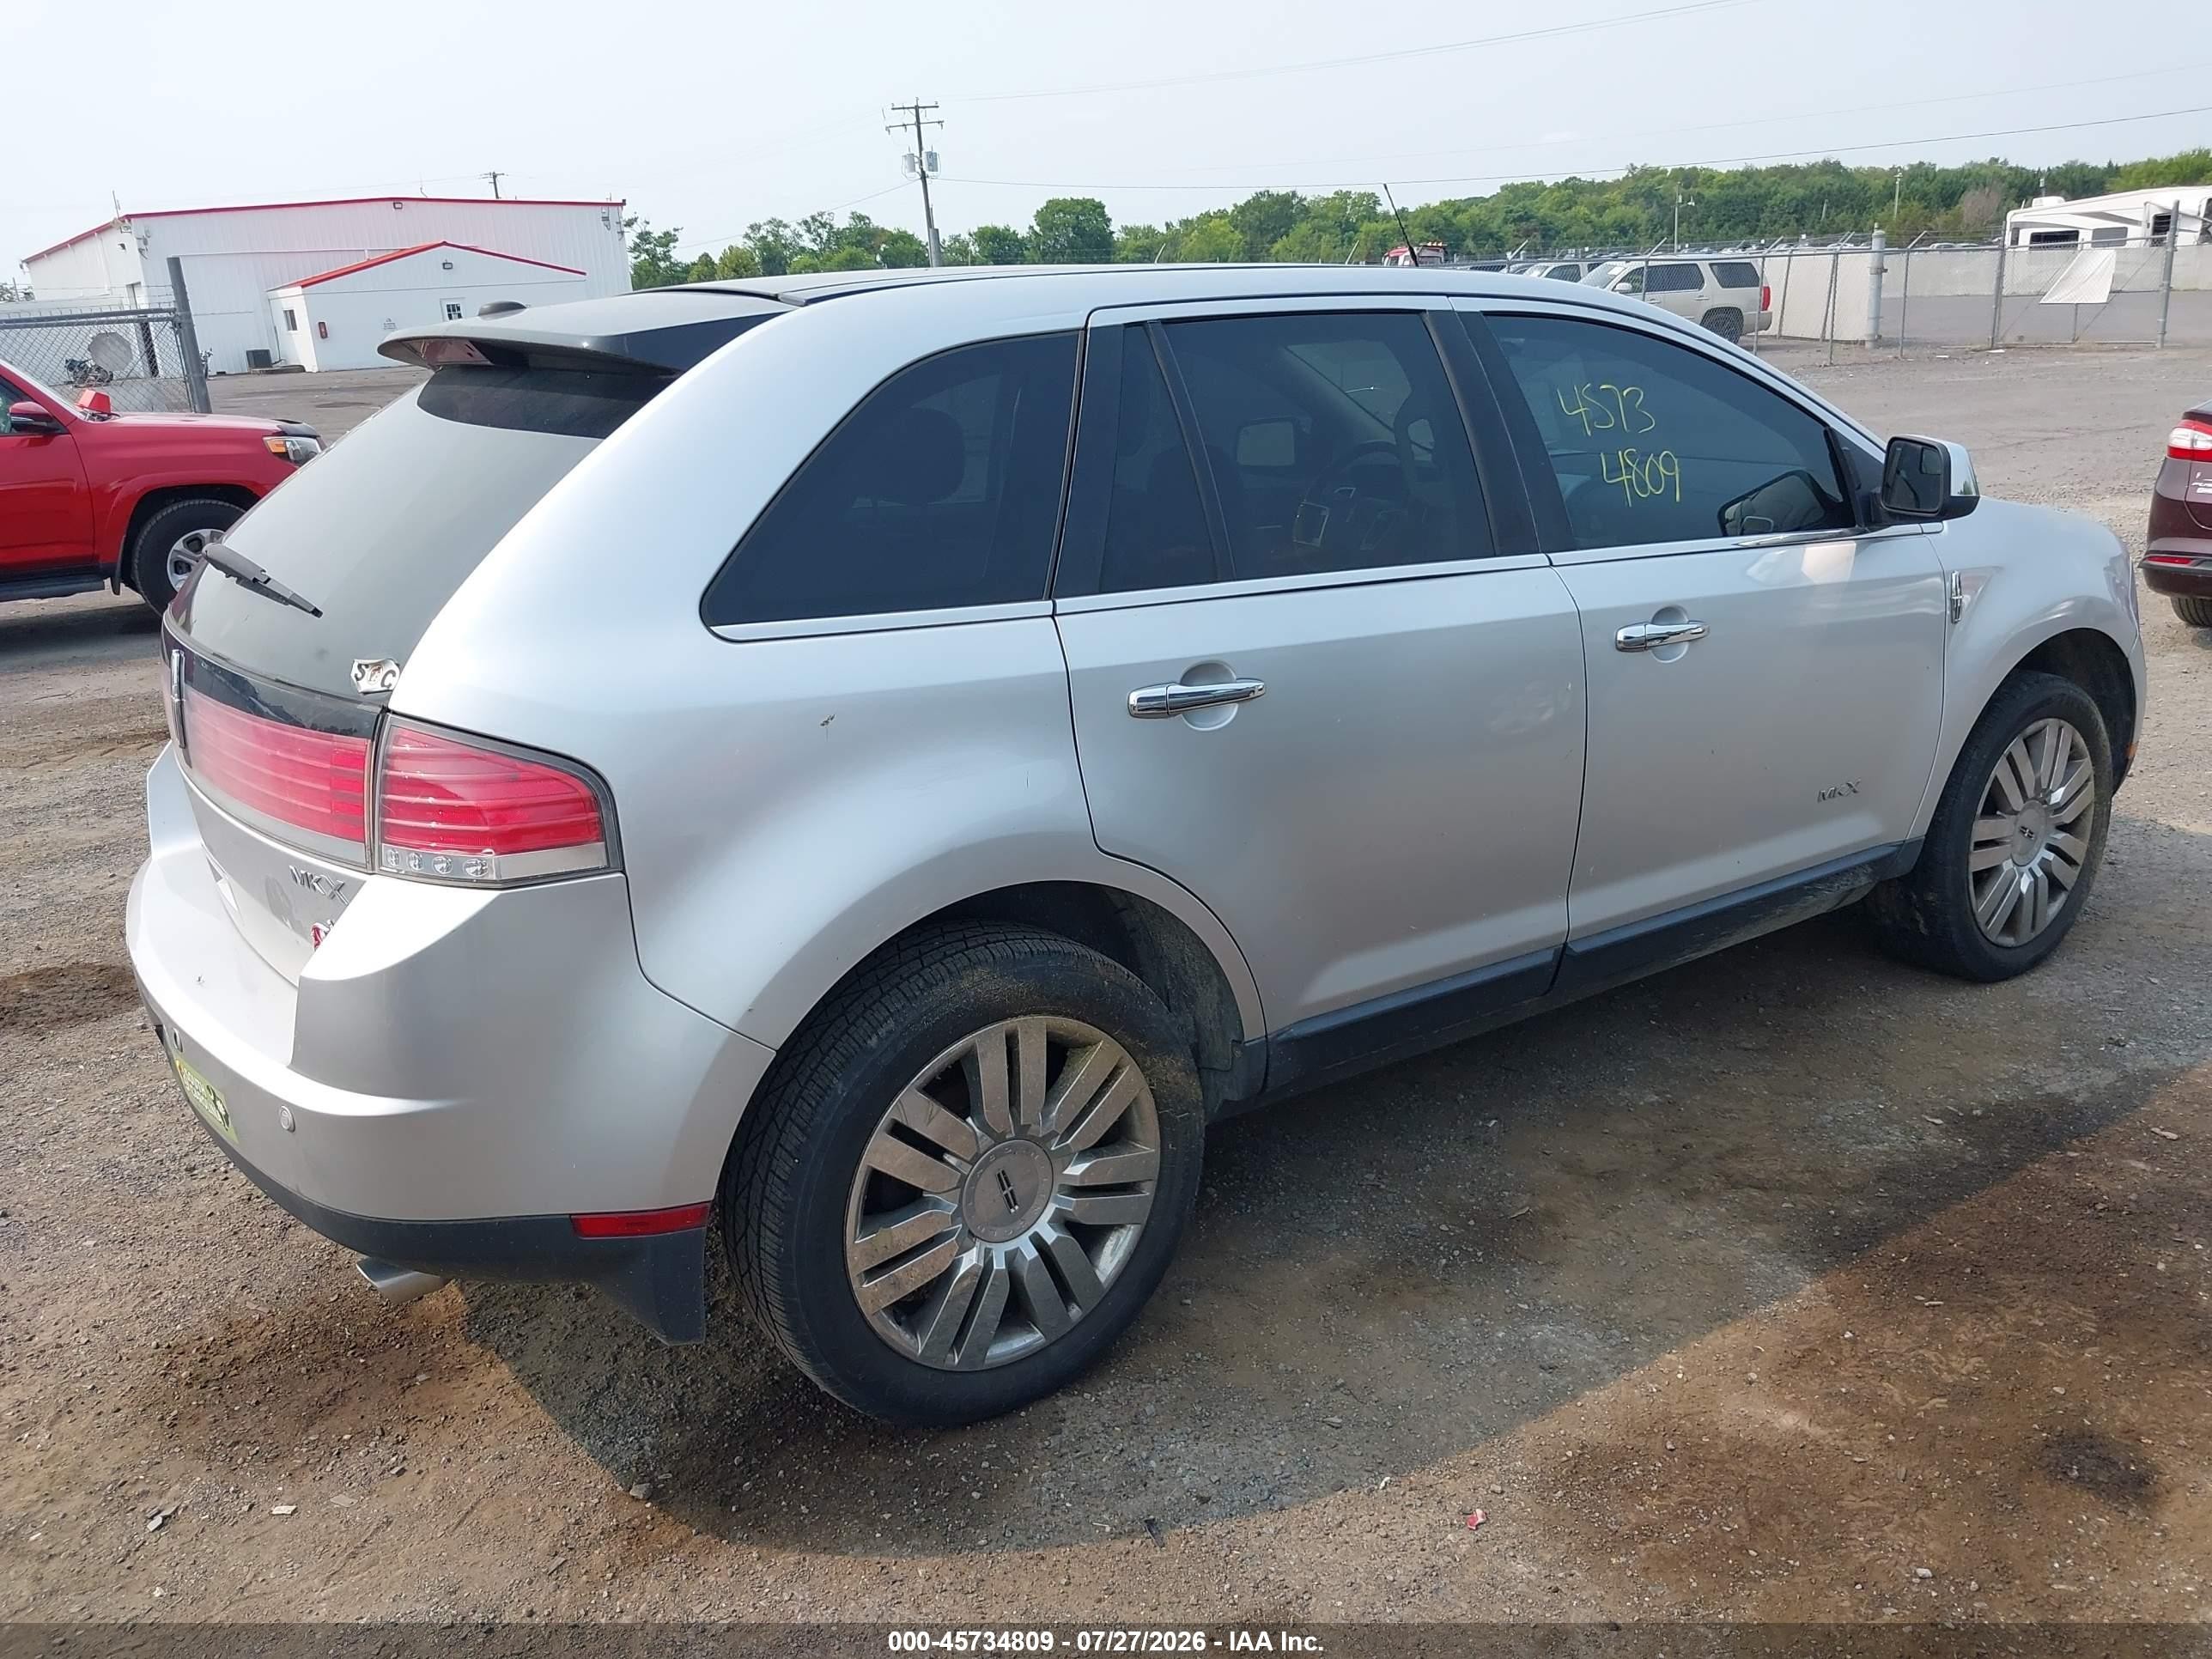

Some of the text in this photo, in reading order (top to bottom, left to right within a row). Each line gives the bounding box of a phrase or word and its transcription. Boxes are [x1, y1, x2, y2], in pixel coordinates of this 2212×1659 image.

[1556, 382, 1656, 436] 4573
[1600, 447, 1681, 507] 4809
[289, 865, 350, 907] MKX
